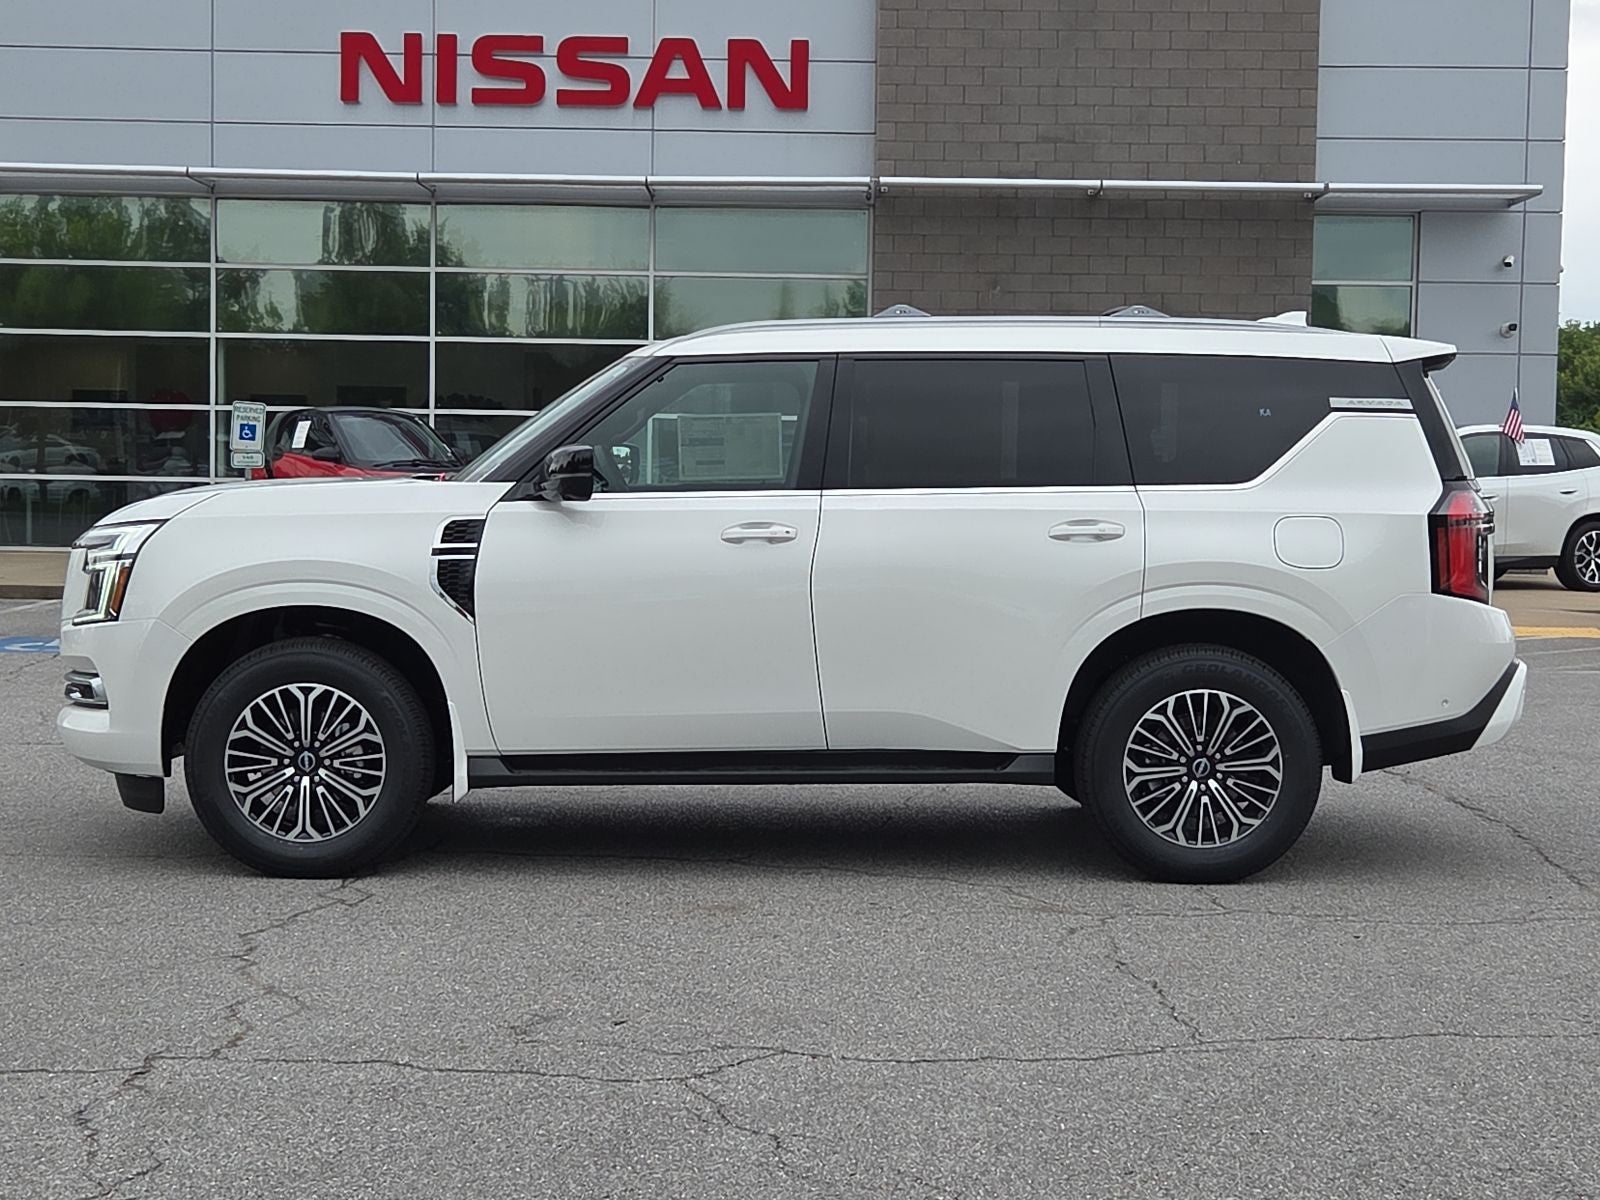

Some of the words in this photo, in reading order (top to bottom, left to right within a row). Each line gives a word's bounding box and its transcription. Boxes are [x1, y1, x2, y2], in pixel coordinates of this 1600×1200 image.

[340, 32, 809, 110] NISSAN
[234, 405, 264, 414] RESERVED
[236, 414, 261, 422] PARKING
